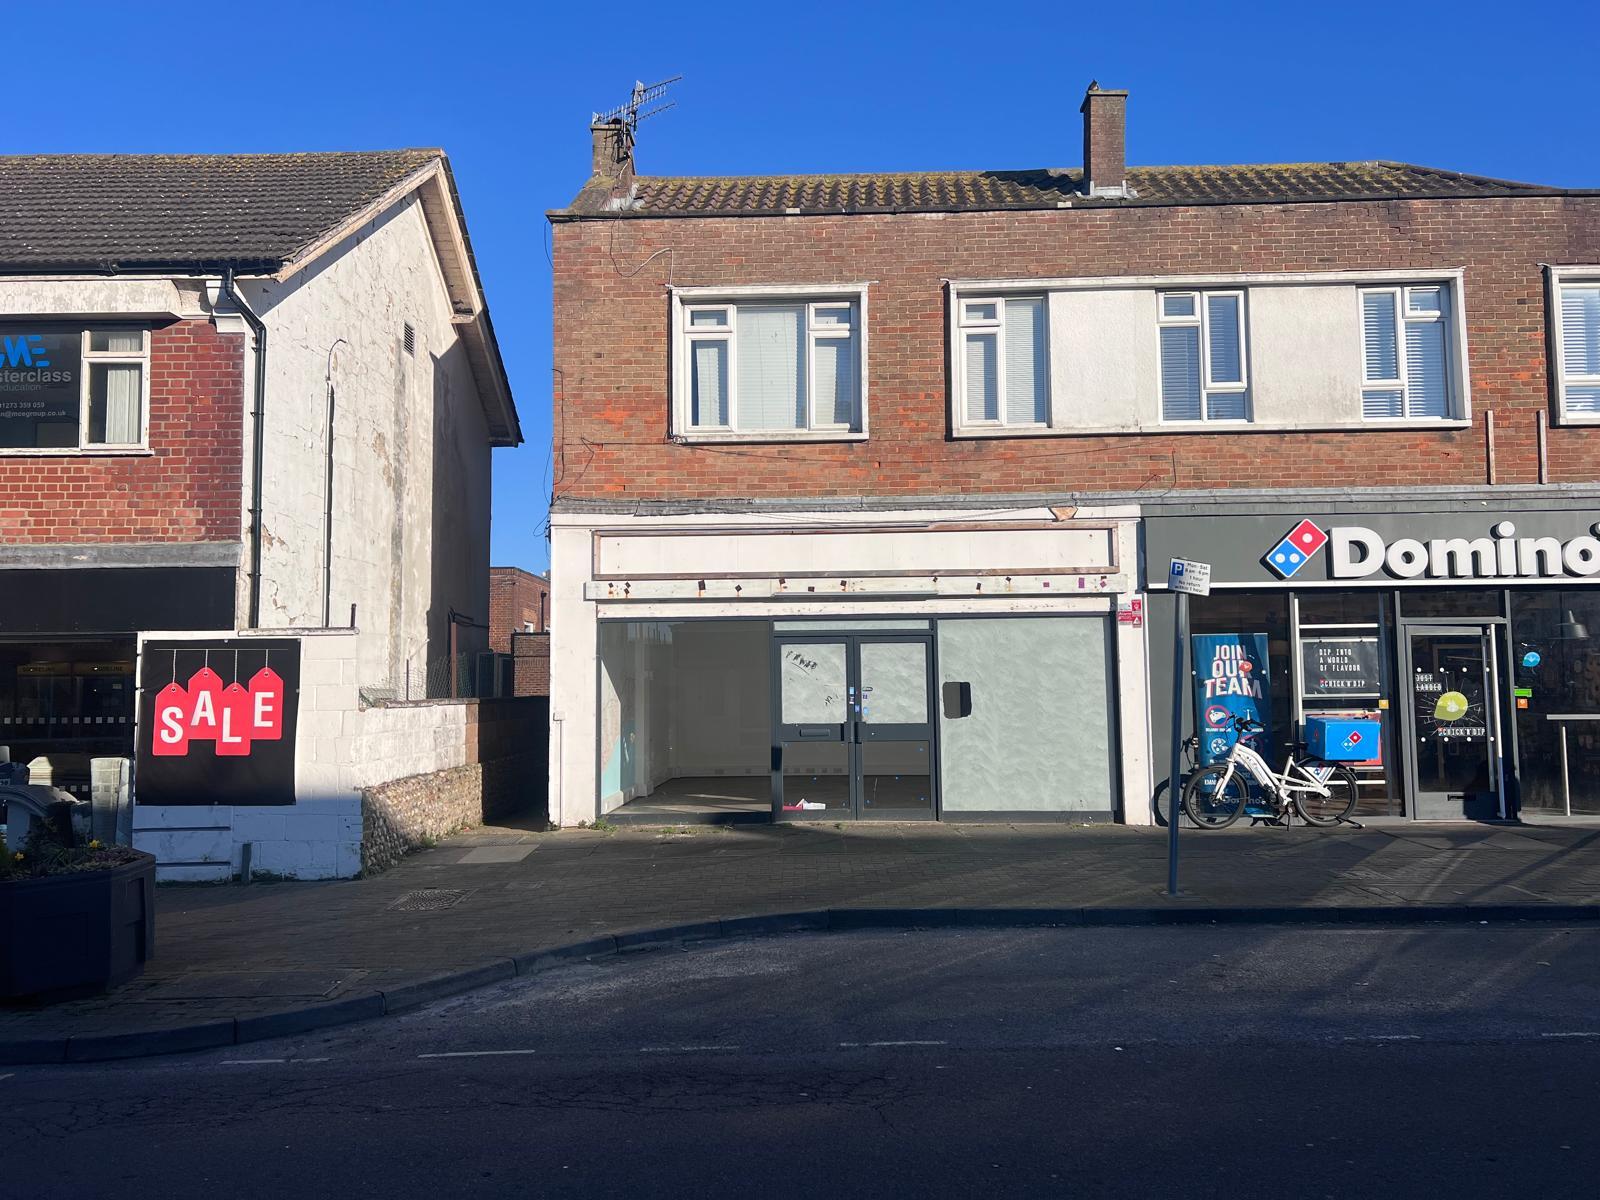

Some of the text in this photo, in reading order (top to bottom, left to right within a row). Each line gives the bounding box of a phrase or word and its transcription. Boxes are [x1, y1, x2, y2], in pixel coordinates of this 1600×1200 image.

[1331, 520, 1600, 578] Domino
[1174, 563, 1183, 575] P
[1213, 644, 1247, 660] JOIN
[1332, 664, 1361, 672] FLAVOUR
[1203, 677, 1263, 699] TEAM
[160, 690, 275, 744] SALE
